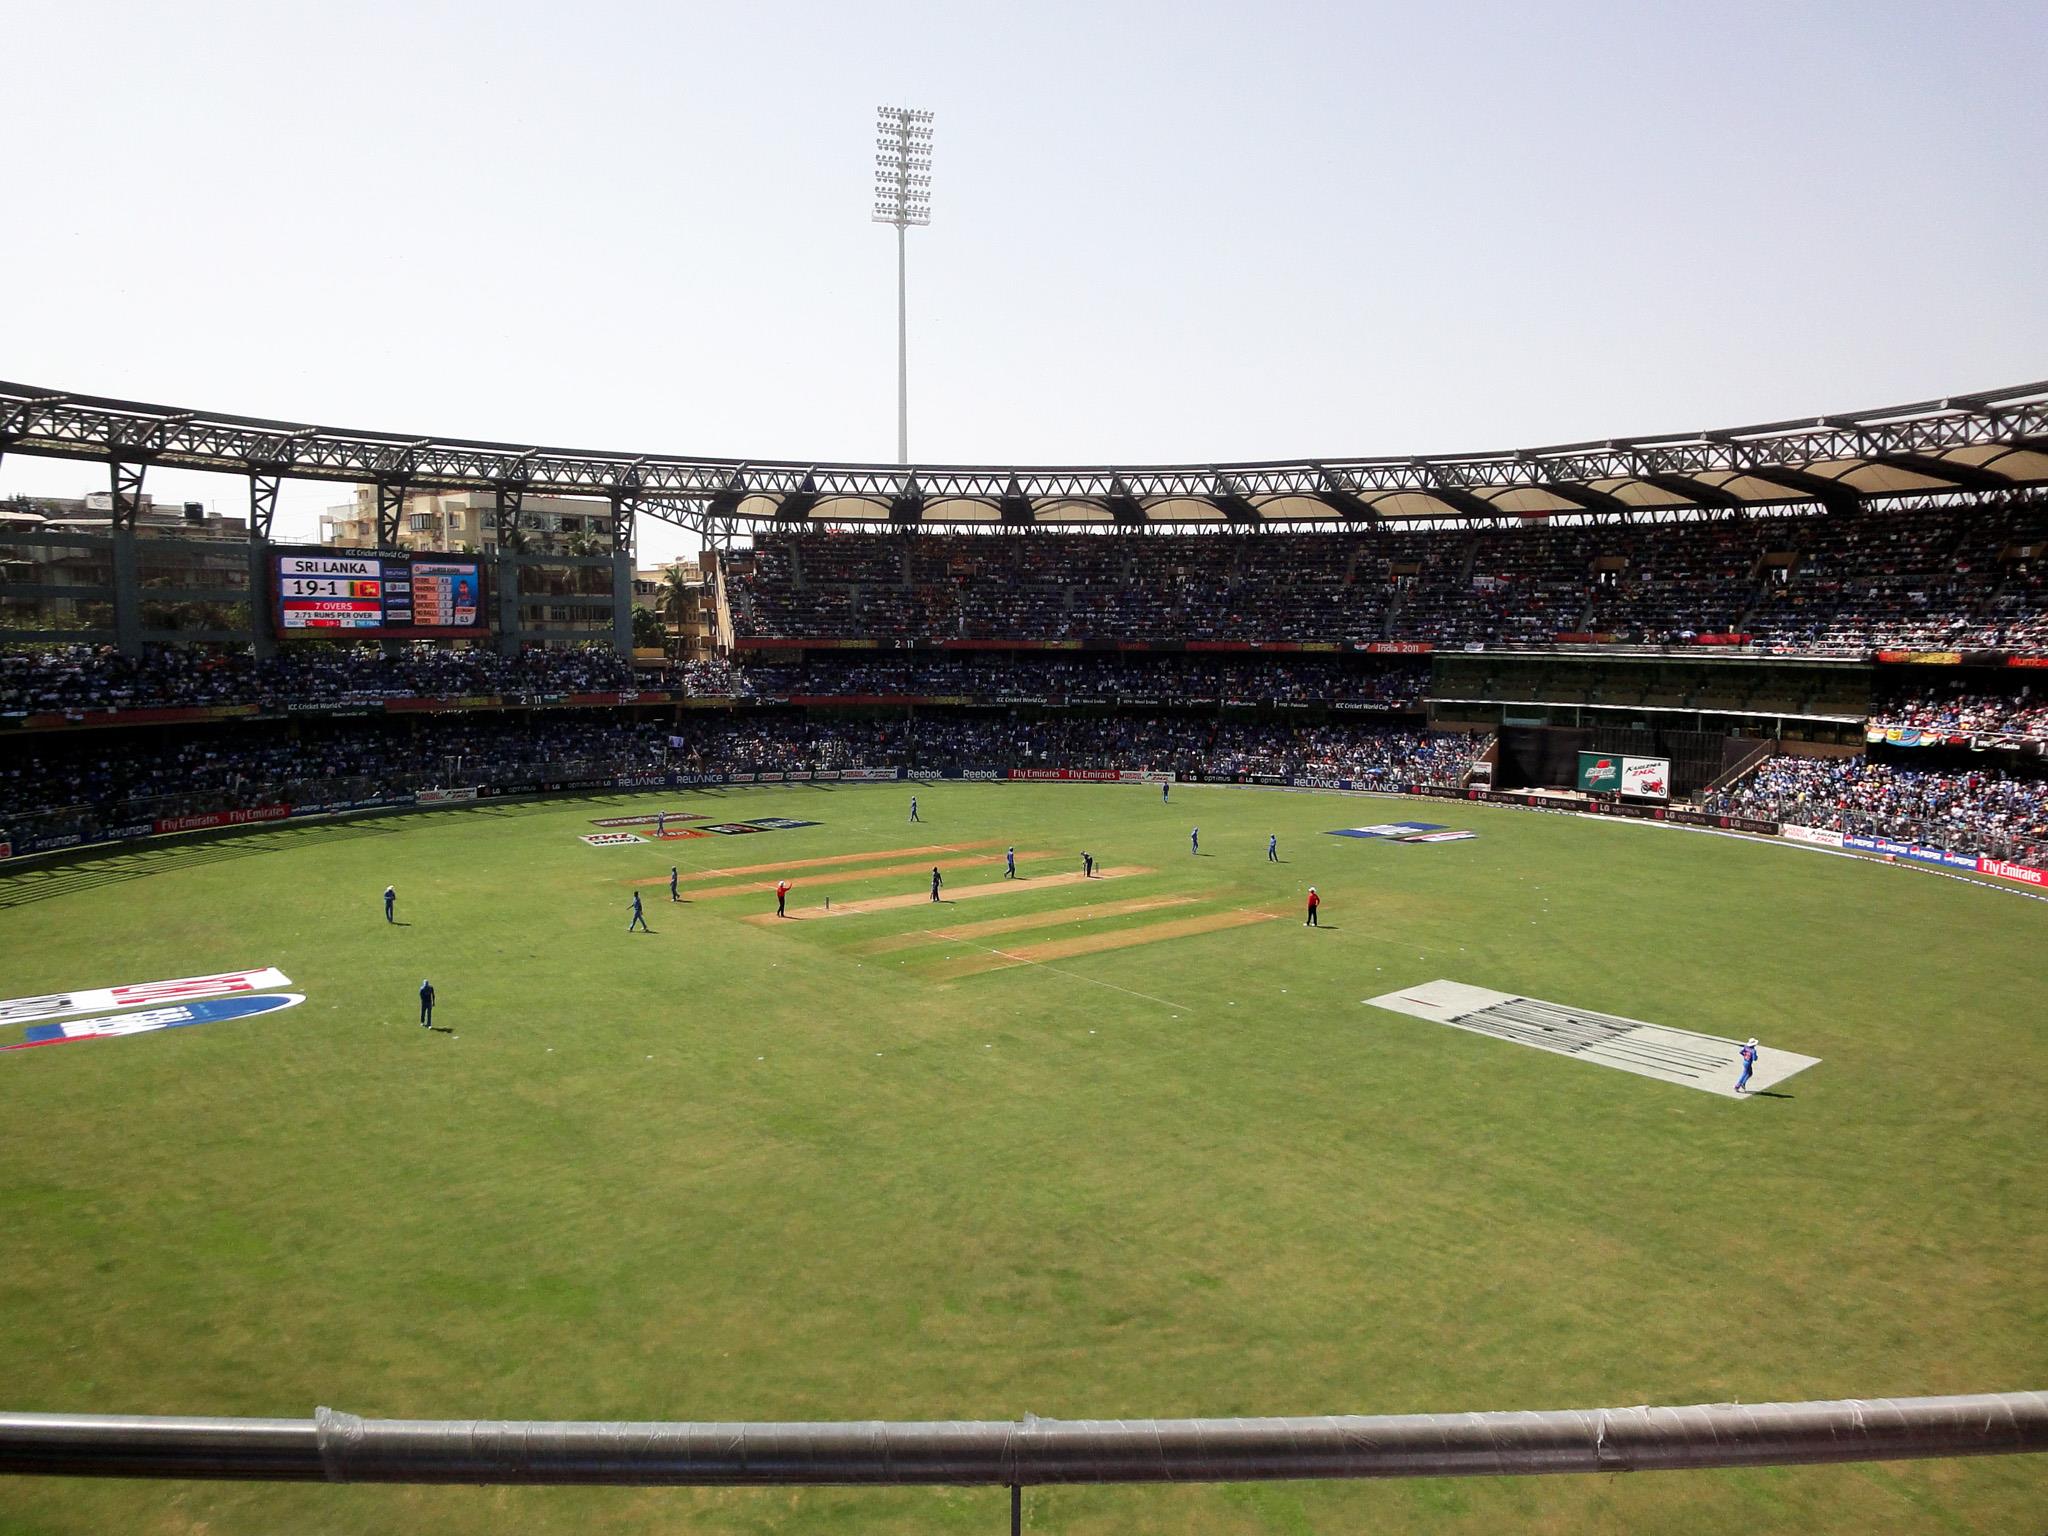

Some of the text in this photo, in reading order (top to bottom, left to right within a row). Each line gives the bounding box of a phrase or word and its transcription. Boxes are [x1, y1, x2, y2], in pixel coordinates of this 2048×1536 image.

[356, 549, 377, 557] Cricket
[378, 551, 397, 559] World
[398, 552, 410, 560] Cup
[296, 561, 368, 574] SRI LANKA
[293, 580, 338, 595] 19-1
[315, 602, 352, 610] 7 OVERS
[1378, 644, 1418, 652] India 2011
[320, 702, 338, 710] World
[907, 769, 942, 778] Reebok
[963, 769, 998, 779] Reebok
[1013, 769, 1060, 778] Fly Emirates
[1068, 770, 1082, 779] Fly
[1082, 770, 1116, 778] Emirates
[1600, 804, 1610, 812] LG
[230, 806, 285, 822] Fly Emirates
[162, 815, 220, 831] Fly Emirates
[1730, 819, 1740, 827] LG
[108, 824, 152, 838] HYUNDAI
[36, 834, 81, 849] HYUNDAI
[1853, 838, 1874, 848] PEPSI
[1887, 844, 1908, 854] PEPSI
[1920, 850, 1941, 860] PEPSI
[1954, 856, 1977, 867] PEPSI
[1983, 859, 2041, 883] Fly Emirates
